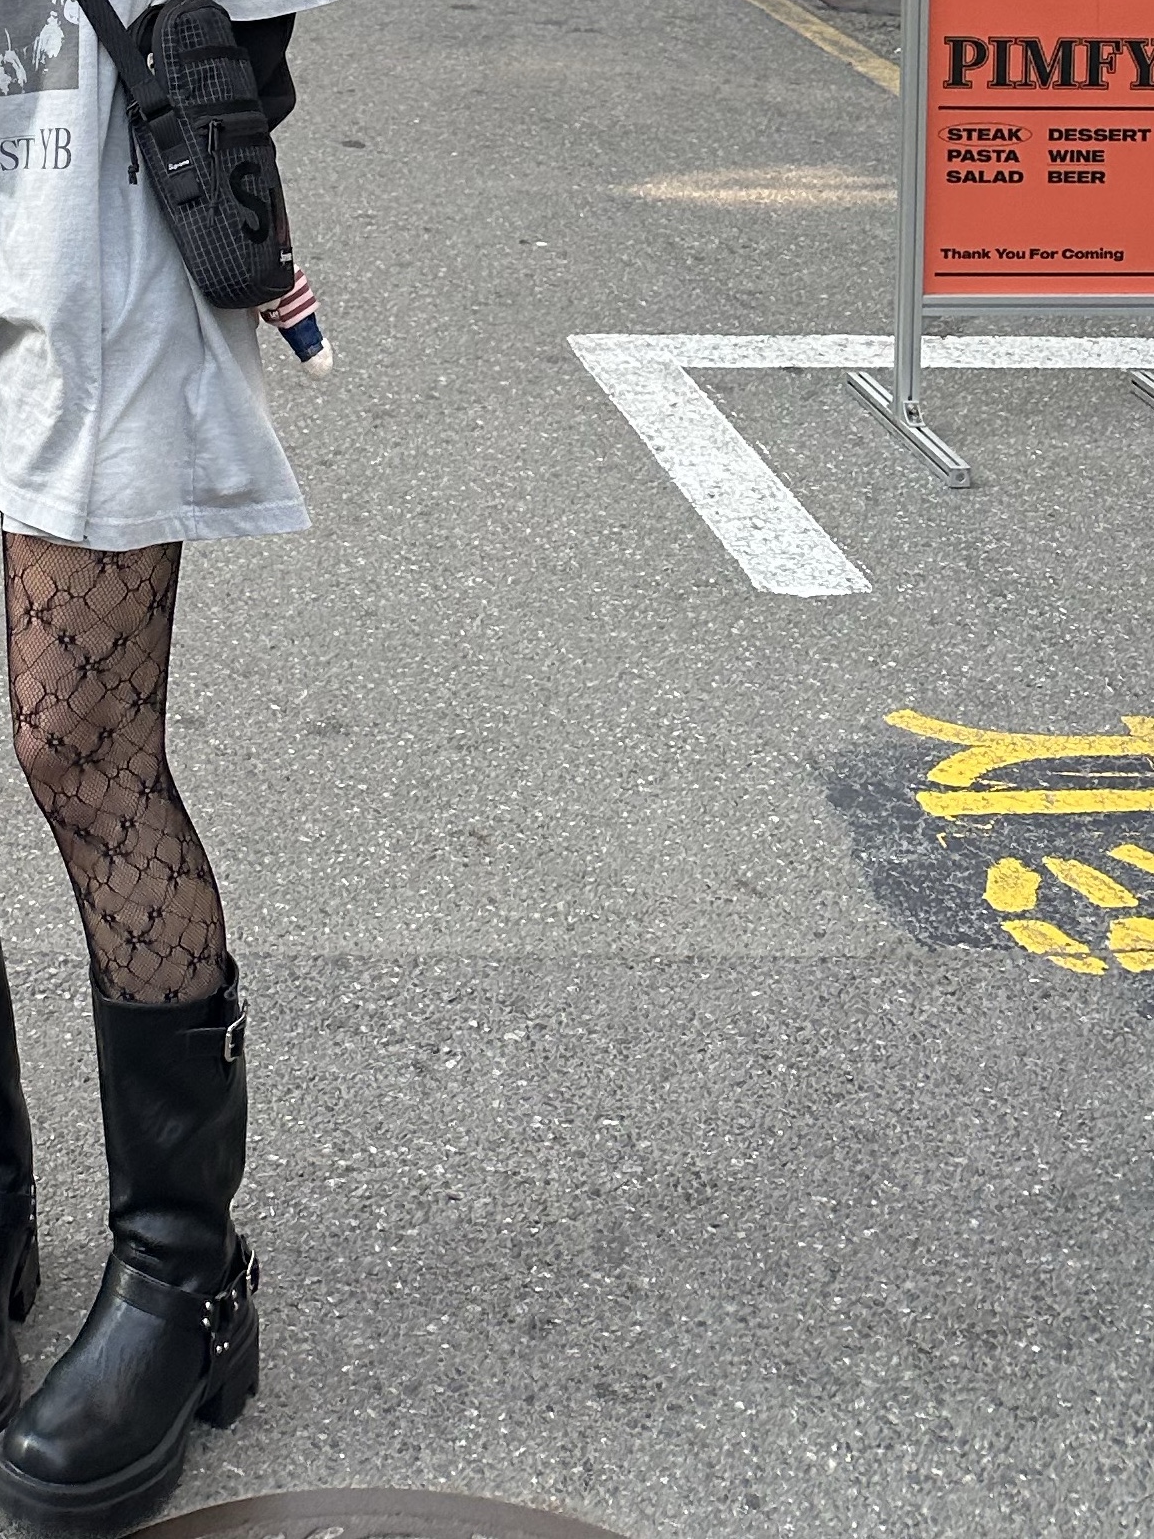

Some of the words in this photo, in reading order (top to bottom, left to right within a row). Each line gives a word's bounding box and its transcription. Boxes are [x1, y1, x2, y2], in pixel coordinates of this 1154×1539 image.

[943, 36, 1154, 91] PIMFY
[947, 128, 1023, 142] STEAK
[1048, 128, 1151, 142] DESSERT
[39, 127, 72, 170] YB
[947, 149, 1020, 163] PASTA
[1048, 149, 1105, 163] WINE
[946, 170, 1024, 184] SALAD
[1047, 170, 1106, 184] BEER
[940, 248, 991, 261] Thank
[995, 249, 1026, 261] You
[1029, 249, 1059, 261] For
[1061, 247, 1125, 262] Coming
